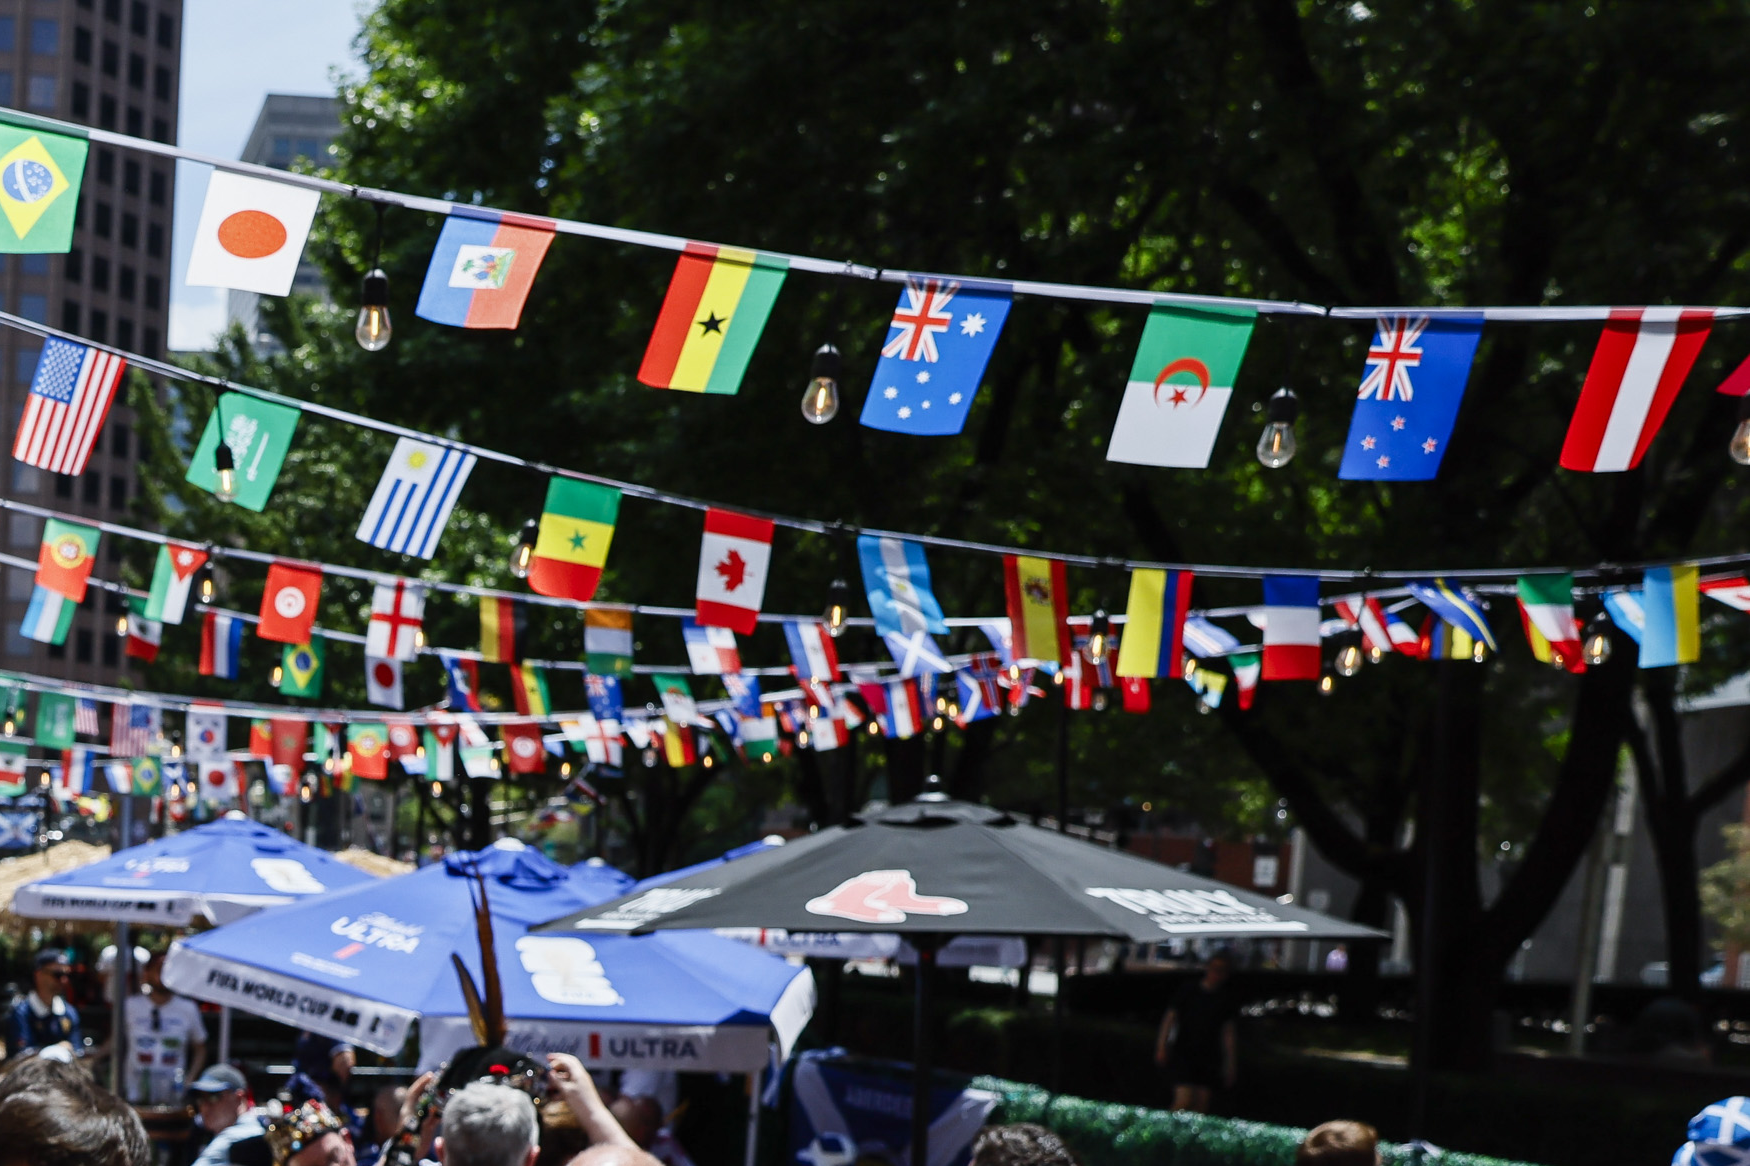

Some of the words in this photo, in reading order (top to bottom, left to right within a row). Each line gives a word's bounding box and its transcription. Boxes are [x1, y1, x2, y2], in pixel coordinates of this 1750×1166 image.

[207, 968, 239, 992] FIFA
[242, 979, 298, 1008] WORLD
[608, 1036, 698, 1060] ULTRA
